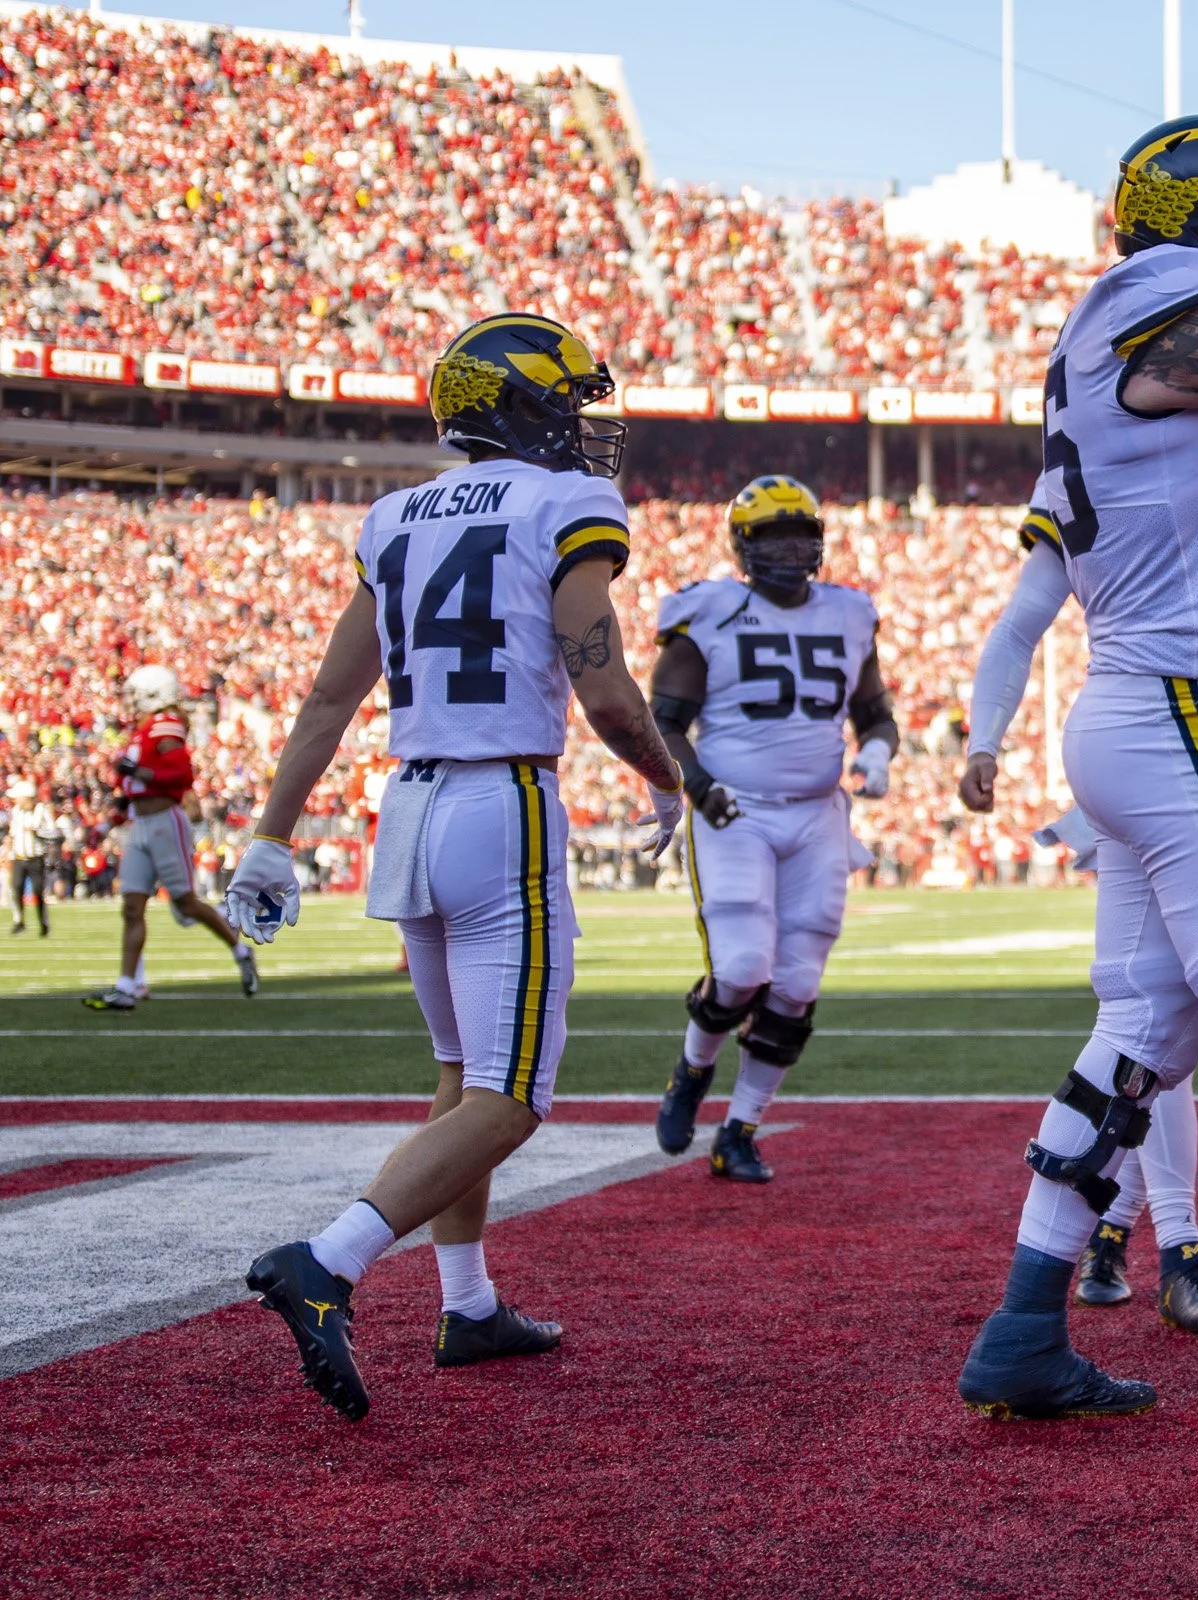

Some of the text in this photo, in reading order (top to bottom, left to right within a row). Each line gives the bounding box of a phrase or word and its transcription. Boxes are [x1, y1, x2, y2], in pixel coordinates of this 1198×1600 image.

[400, 481, 512, 524] WILSON
[376, 523, 510, 711] 14
[736, 633, 848, 722] 55
